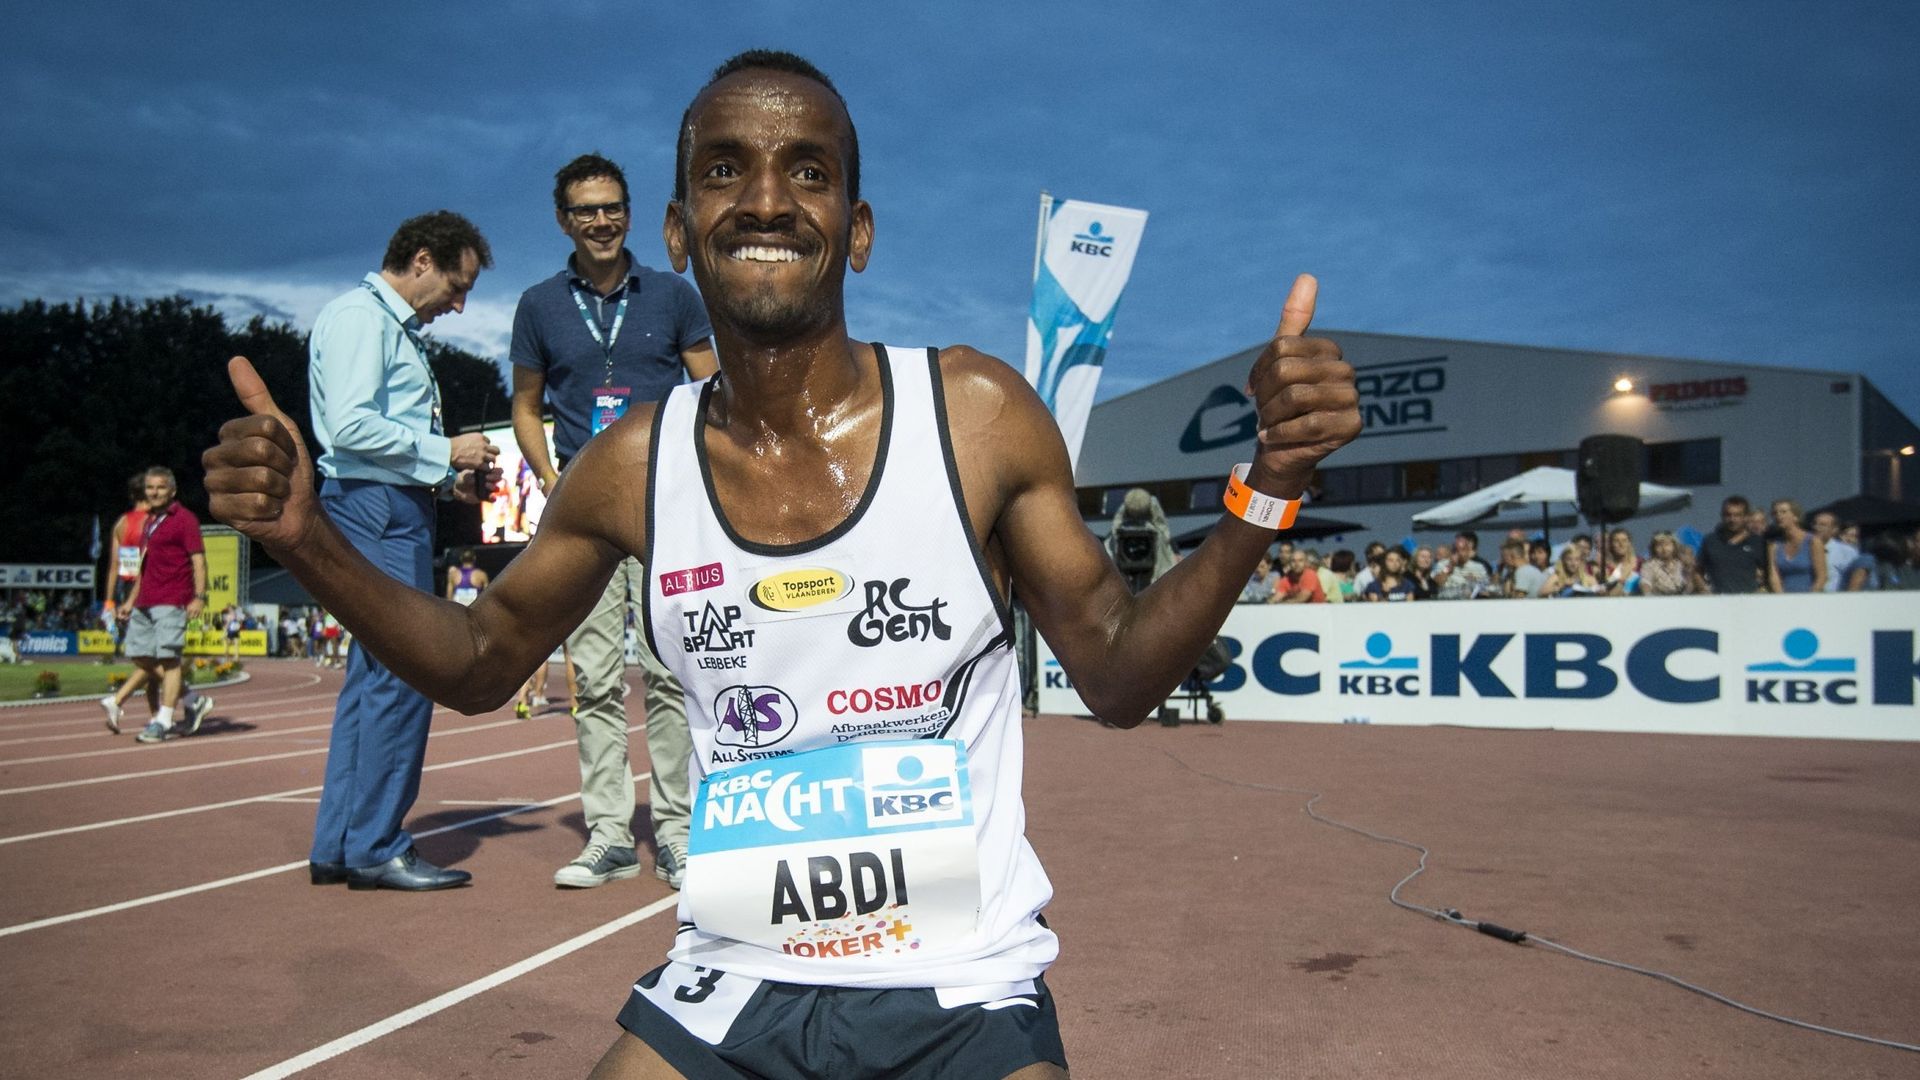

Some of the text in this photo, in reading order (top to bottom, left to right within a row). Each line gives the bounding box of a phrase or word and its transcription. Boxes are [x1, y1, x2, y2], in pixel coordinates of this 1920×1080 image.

[1070, 241, 1112, 257] KBC
[37, 569, 91, 583] KBC
[783, 577, 835, 591] Topsport
[786, 588, 836, 599] VLAANDEREN
[847, 597, 952, 647] Gent
[697, 656, 747, 669] LEBBEKE
[1430, 628, 1720, 704] KBC
[1339, 674, 1420, 696] KBC
[1746, 678, 1857, 705] KBC
[827, 680, 942, 715] COSMO
[830, 710, 948, 733] Afbraakwerken
[837, 721, 944, 742] Dendermonde
[708, 769, 773, 799] KBC
[703, 771, 853, 831] NACHT
[872, 791, 956, 817] KBC
[770, 848, 909, 925] ABDI
